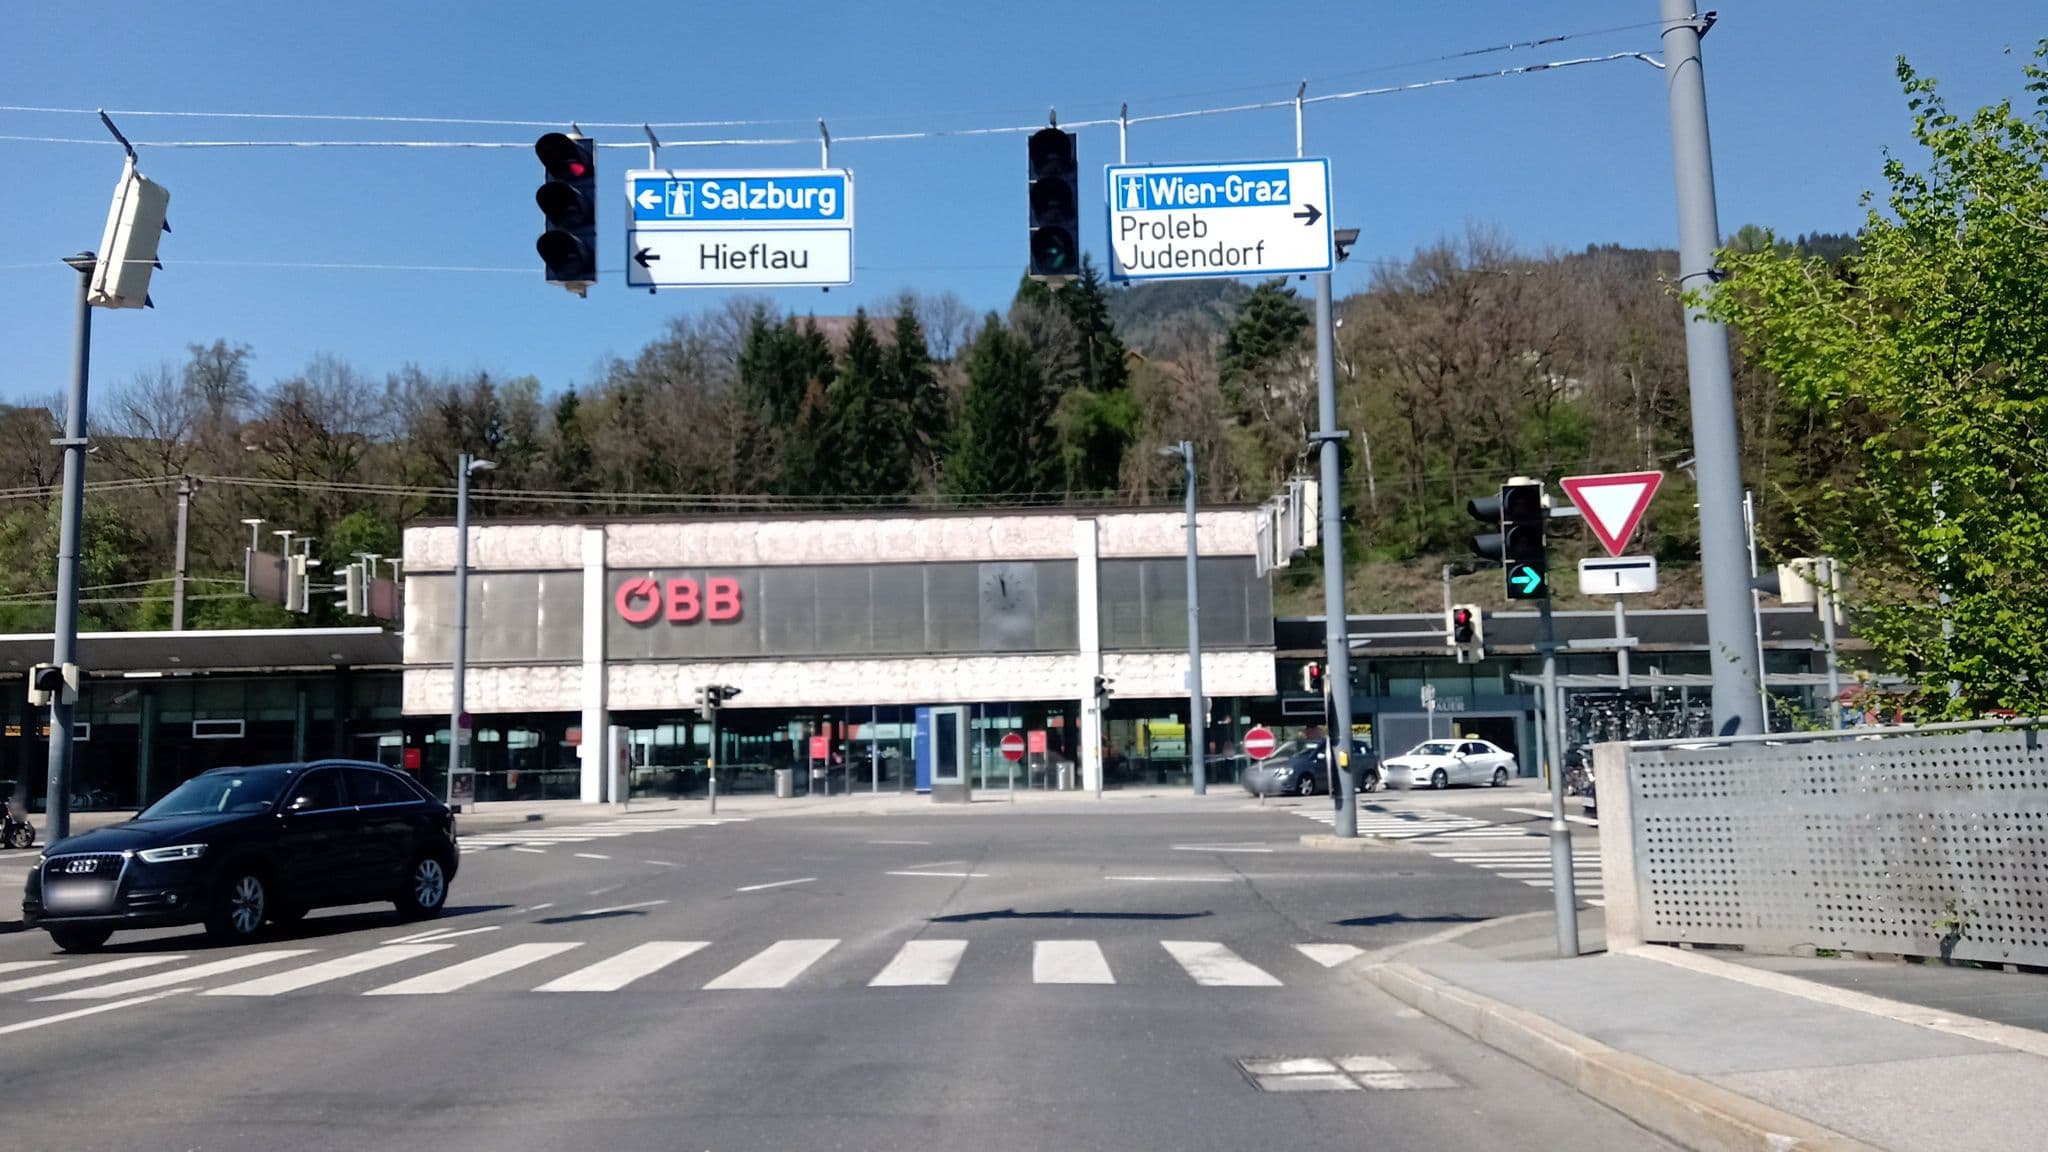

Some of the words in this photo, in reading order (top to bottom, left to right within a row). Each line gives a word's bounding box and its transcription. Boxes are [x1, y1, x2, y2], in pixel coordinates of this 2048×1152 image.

[701, 181, 836, 216] Salzburg
[1149, 175, 1287, 206] Wien-Graz
[1121, 213, 1207, 241] Proleb
[700, 244, 808, 270] Hieflau
[1122, 240, 1265, 270] Judendorf
[615, 577, 742, 623] ÖBB
